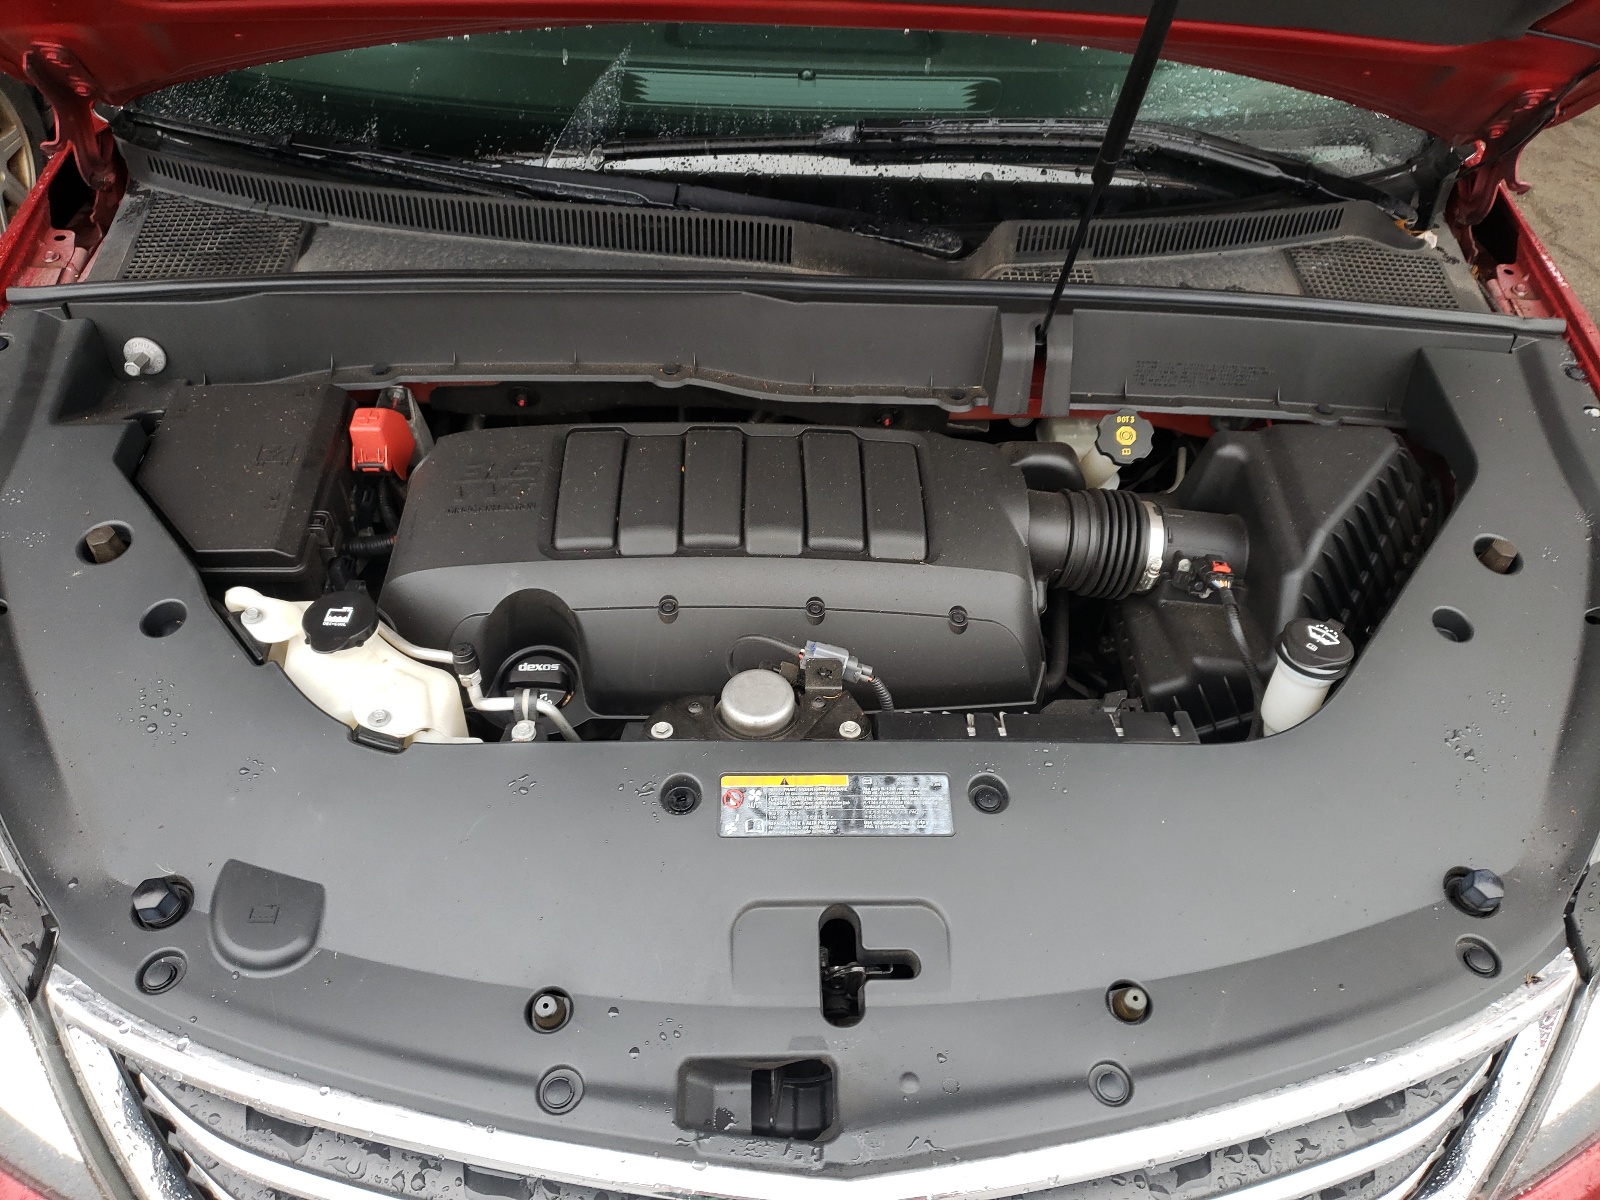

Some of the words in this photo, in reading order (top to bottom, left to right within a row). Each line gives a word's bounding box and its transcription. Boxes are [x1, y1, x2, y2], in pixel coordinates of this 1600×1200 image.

[1116, 415, 1130, 423] DOT
[1130, 415, 1135, 423] 3
[518, 662, 560, 671] dexos
